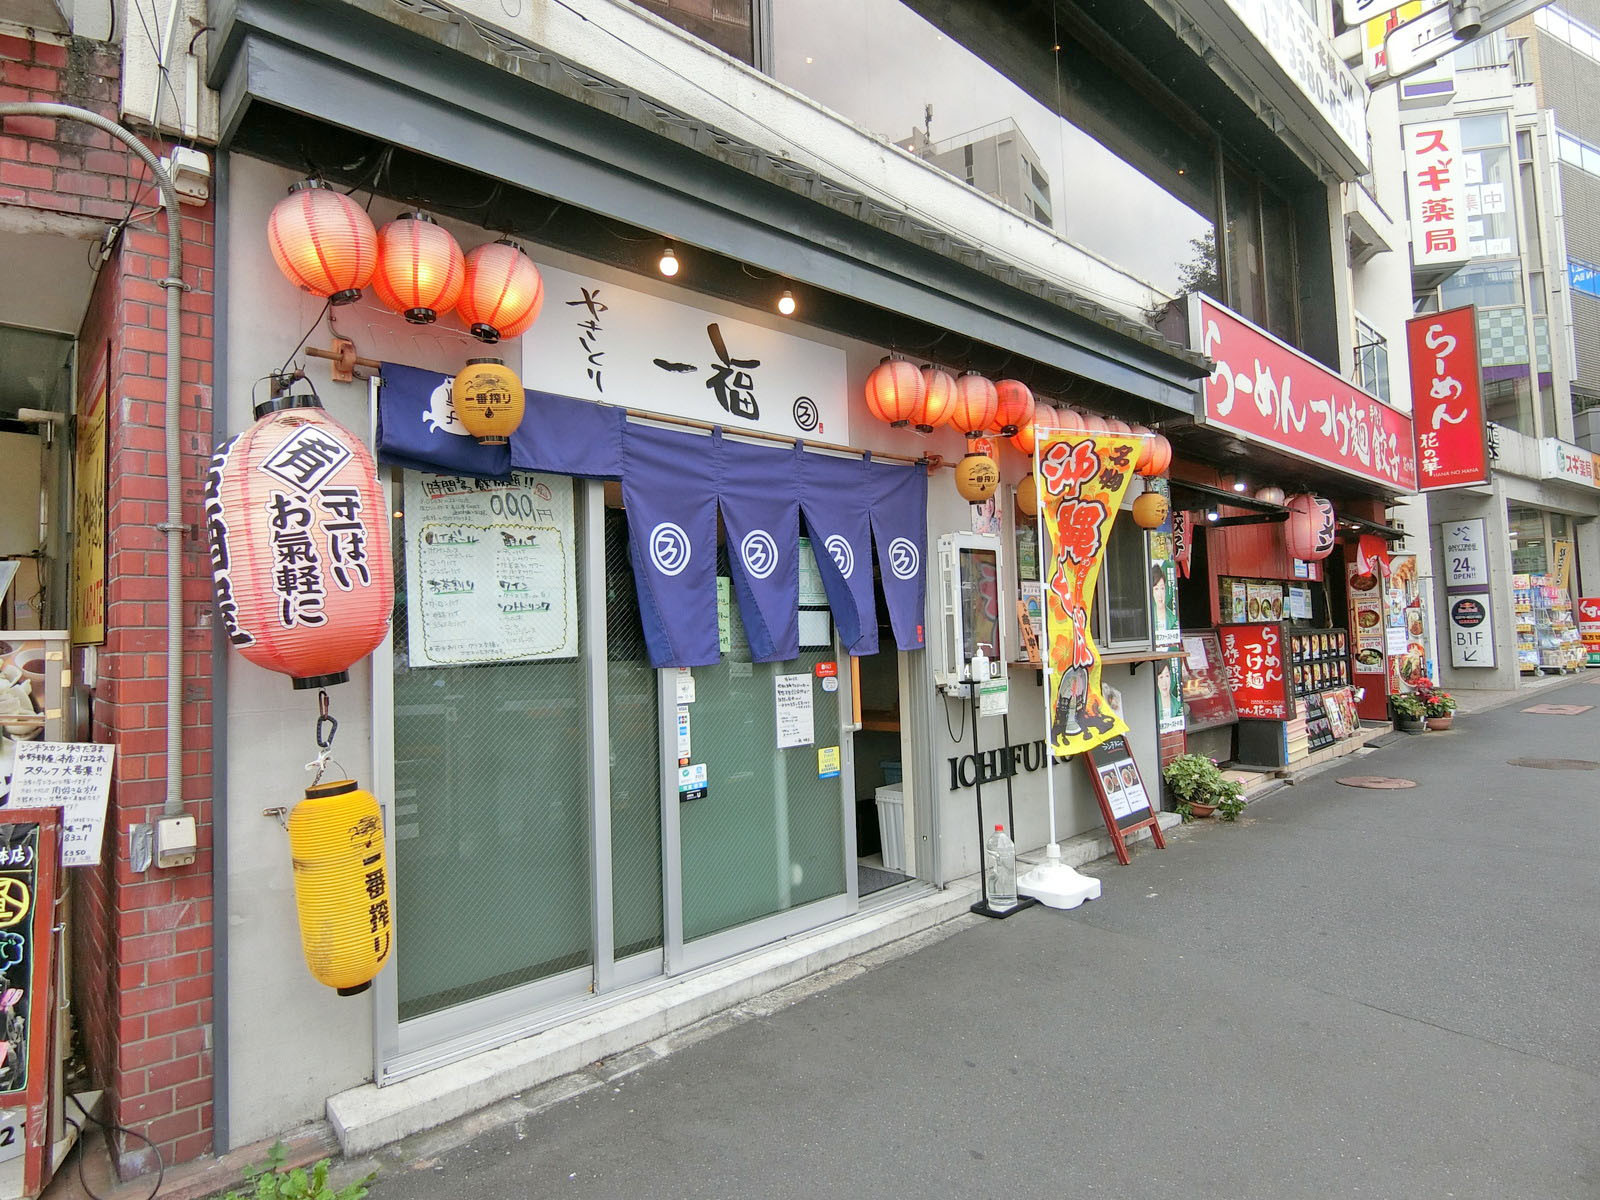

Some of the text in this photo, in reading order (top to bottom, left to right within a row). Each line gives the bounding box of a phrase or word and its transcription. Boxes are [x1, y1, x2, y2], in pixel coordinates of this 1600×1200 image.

[1415, 129, 1457, 255] スギ薬局
[565, 287, 608, 393] やきとり
[465, 393, 511, 405] 一番搾り
[653, 323, 760, 420] 一福
[1205, 320, 1306, 434] らーめん
[1425, 324, 1468, 429] らーめん
[1310, 395, 1370, 467] つけ麺
[1372, 424, 1400, 482] 餃子
[1420, 432, 1443, 477] 花の華
[275, 437, 340, 484] 肴
[968, 475, 996, 483] 一番搾り
[1100, 444, 1133, 491] 名物
[1461, 467, 1479, 475] HANA
[1565, 454, 1593, 479] スギ薬局
[271, 494, 324, 626] お氣軽に
[320, 489, 370, 588] 一寸一ぱい
[1262, 627, 1282, 682] らーめん
[1456, 631, 1483, 646] B1F
[1244, 643, 1264, 690] つけ麺
[24, 766, 59, 776] スタッフ
[362, 852, 390, 964] 一番搾り
